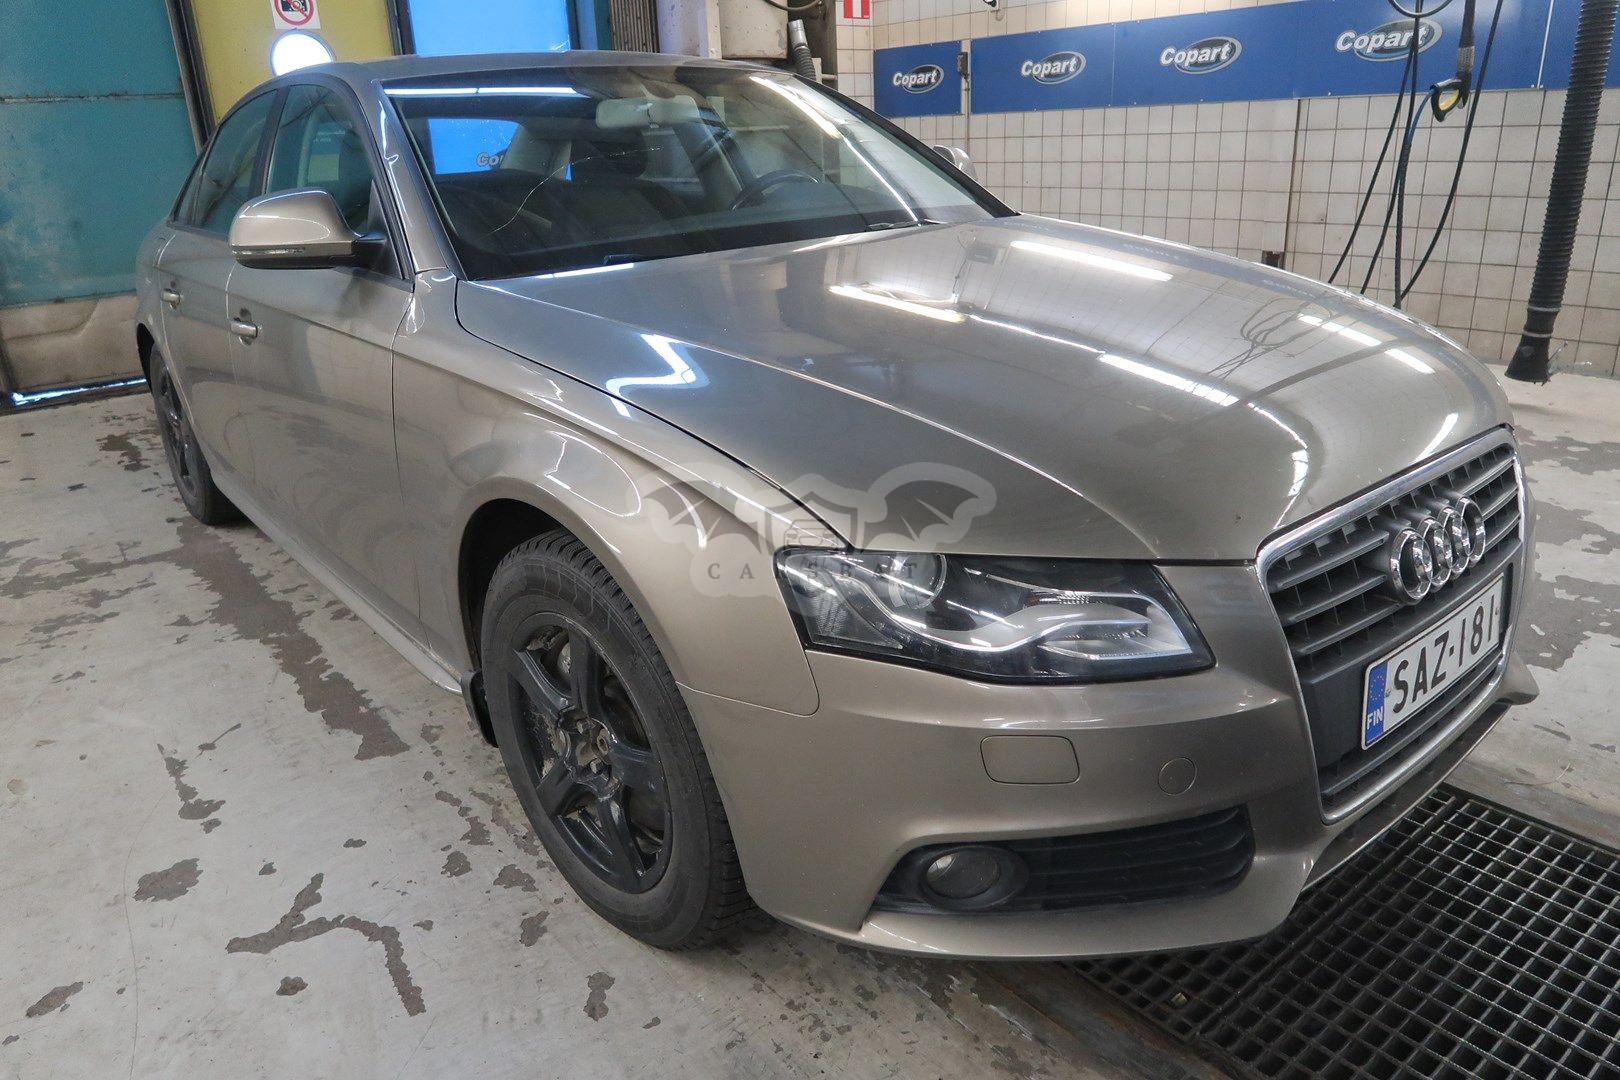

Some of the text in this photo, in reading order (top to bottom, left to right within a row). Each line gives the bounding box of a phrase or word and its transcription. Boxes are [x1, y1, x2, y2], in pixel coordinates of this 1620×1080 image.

[1336, 24, 1430, 55] Copart
[1159, 42, 1232, 67] Copart
[892, 69, 938, 87] Copart
[1021, 56, 1078, 78] Copart
[1392, 594, 1495, 714] SAZ-181
[1366, 706, 1384, 730] FIN
